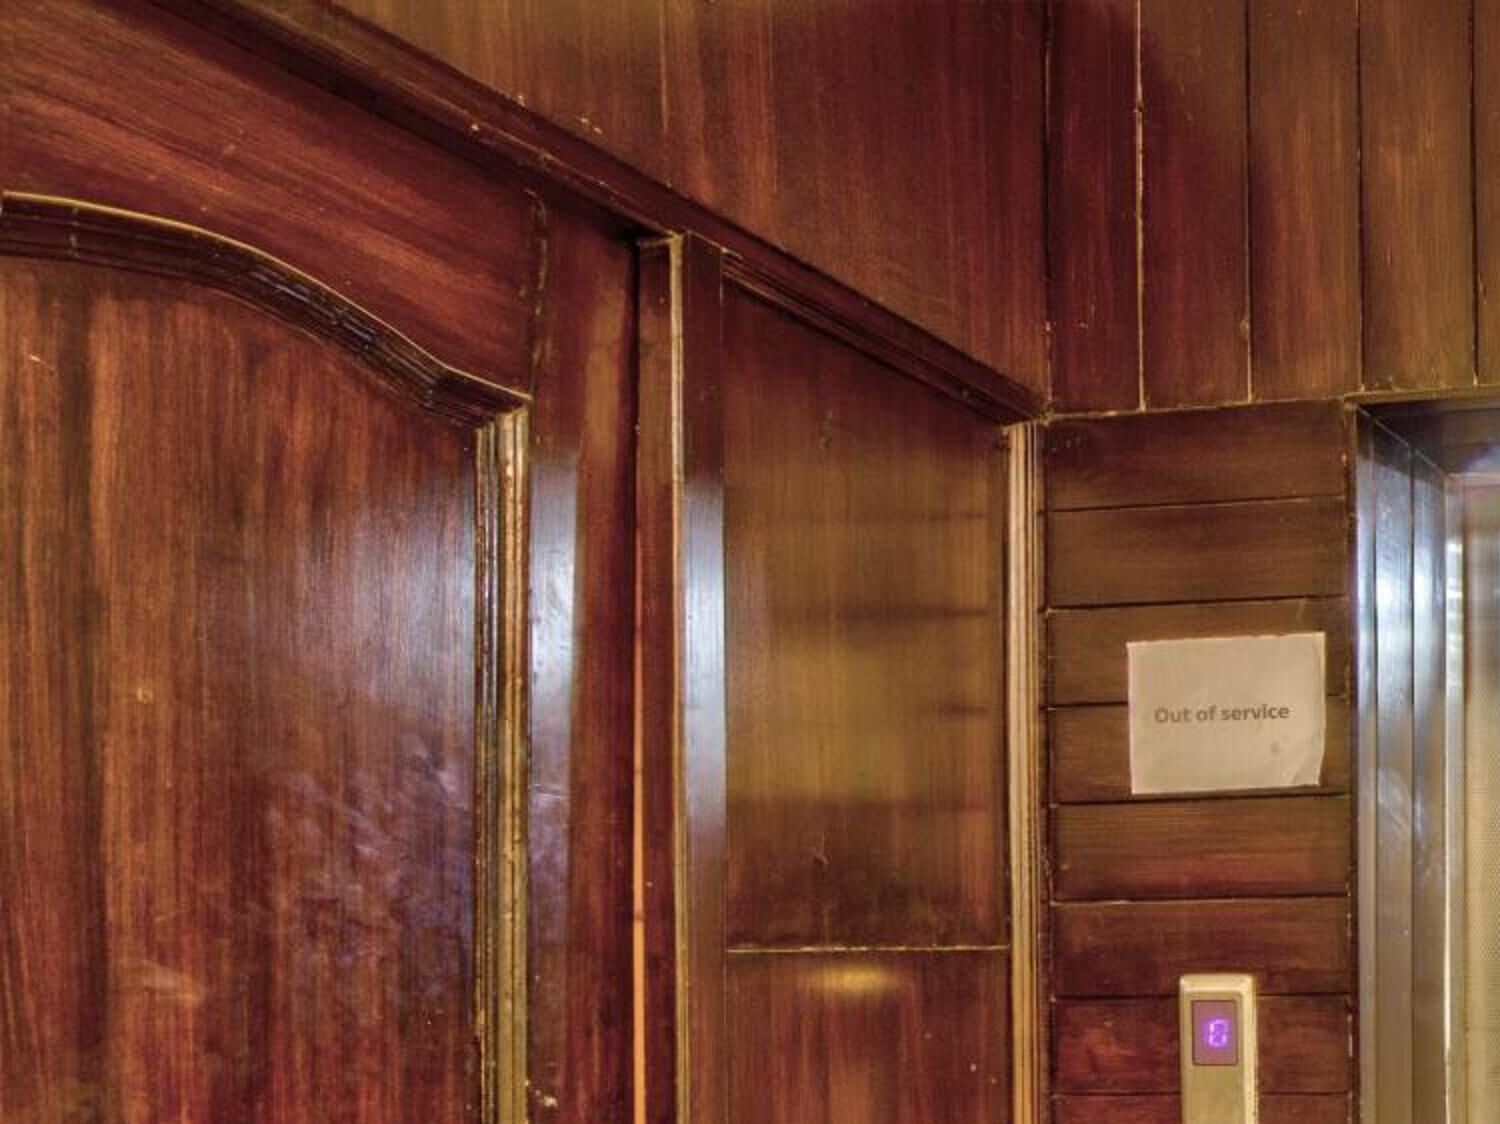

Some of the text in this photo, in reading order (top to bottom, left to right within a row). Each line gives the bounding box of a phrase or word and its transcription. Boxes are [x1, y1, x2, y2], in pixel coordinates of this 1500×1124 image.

[1154, 703, 1290, 724] Out of service
